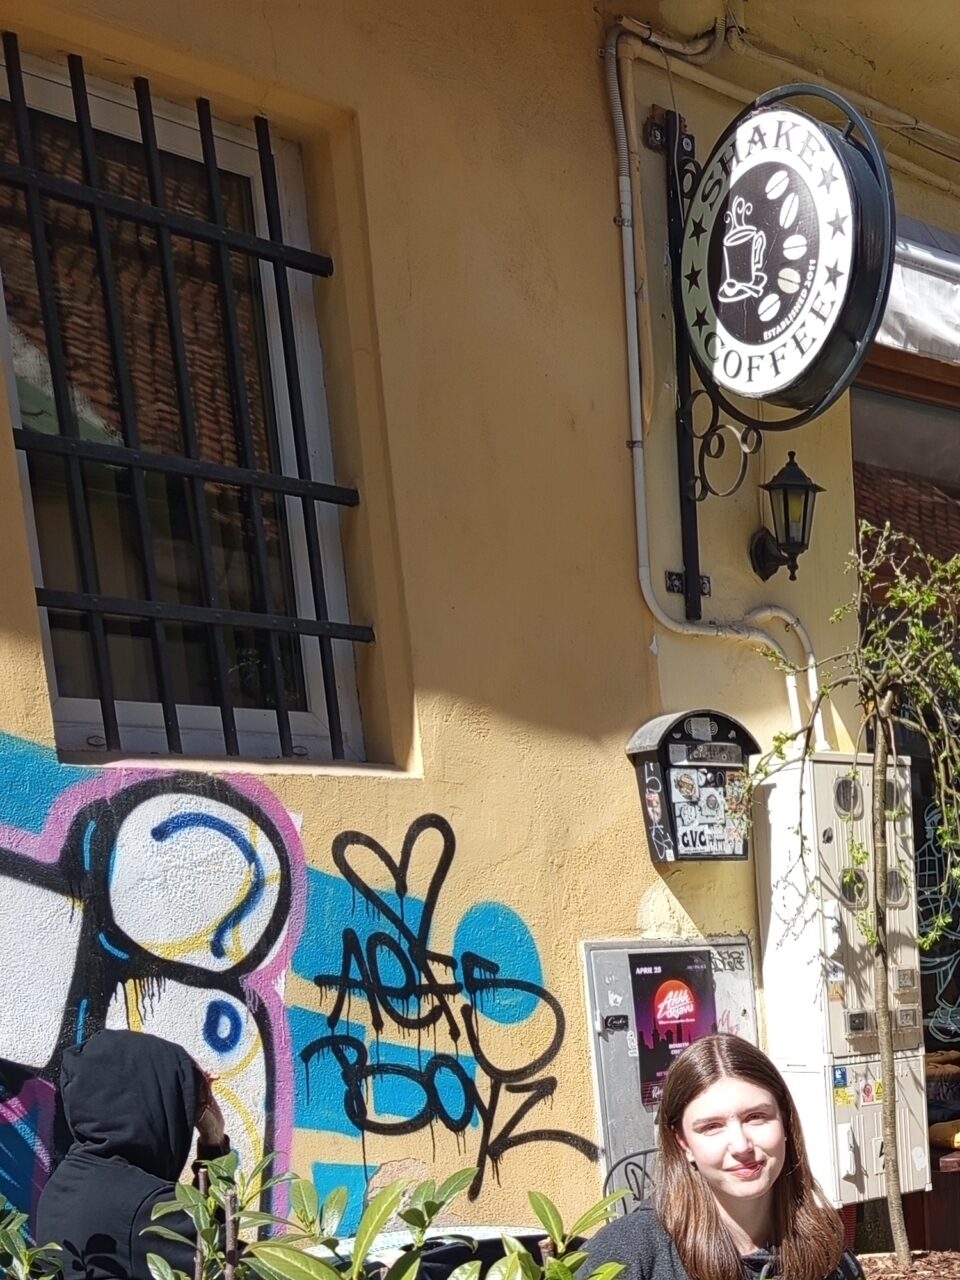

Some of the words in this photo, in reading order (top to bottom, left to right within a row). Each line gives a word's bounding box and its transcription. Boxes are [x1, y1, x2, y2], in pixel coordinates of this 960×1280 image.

[701, 119, 826, 212] SHAKE
[704, 289, 837, 384] COFFEE
[763, 288, 808, 341] ESTABLISHED
[803, 259, 816, 288] 2011
[635, 967, 652, 975] APRIL
